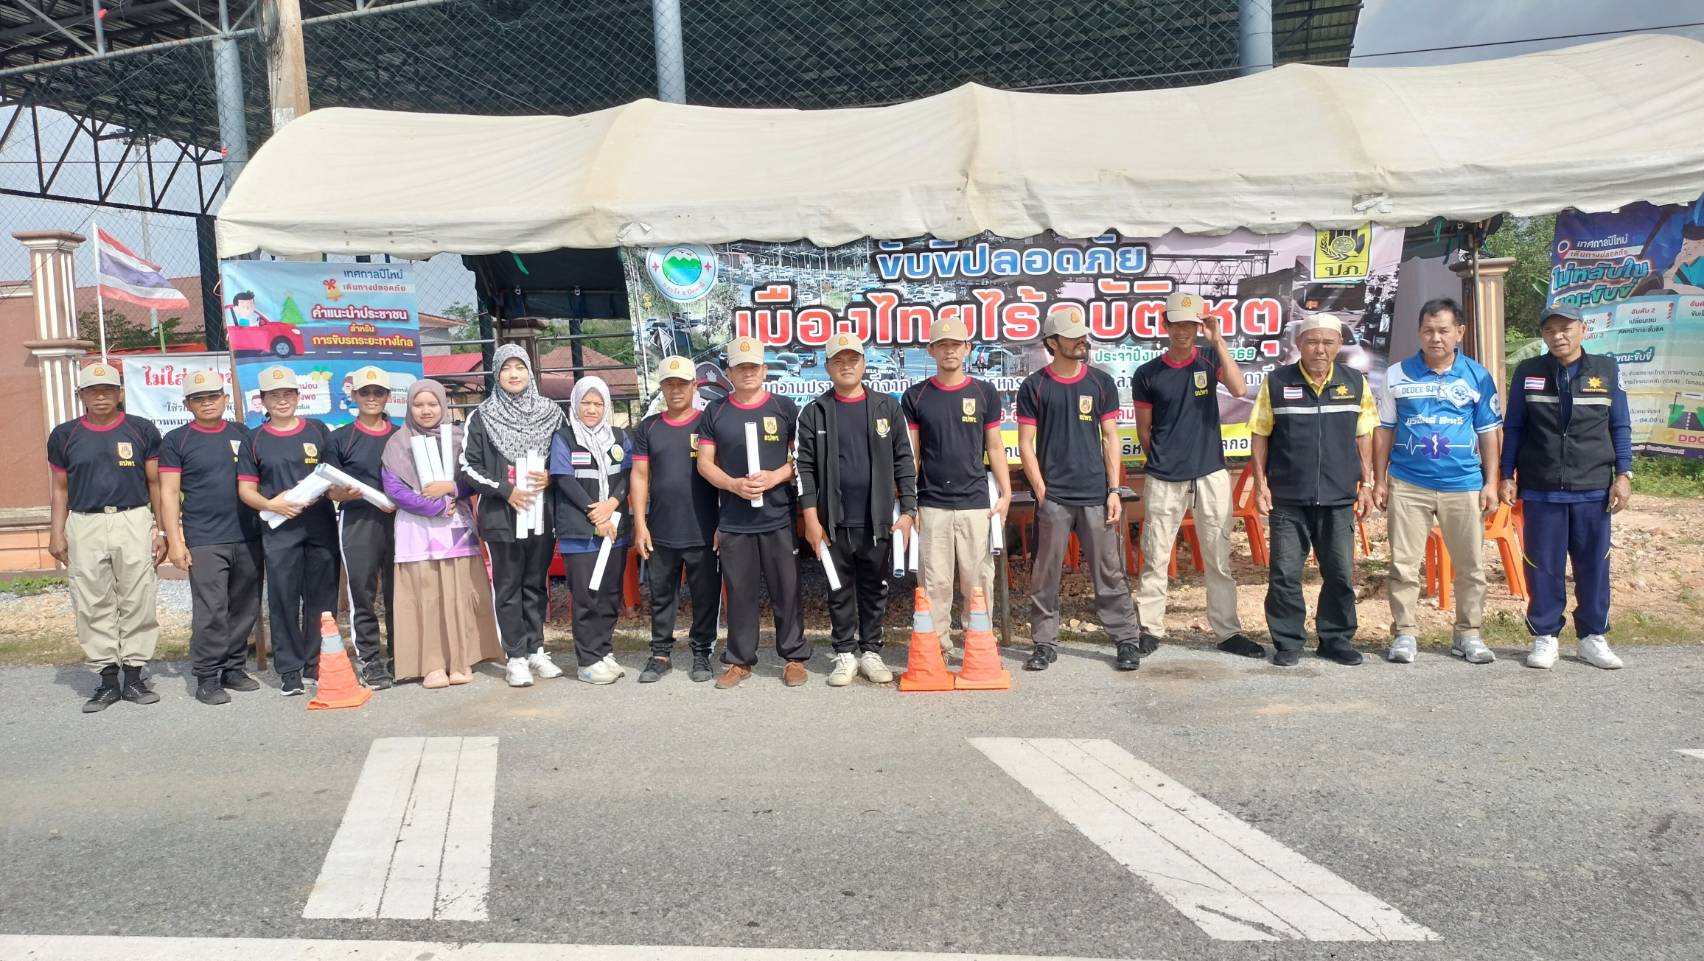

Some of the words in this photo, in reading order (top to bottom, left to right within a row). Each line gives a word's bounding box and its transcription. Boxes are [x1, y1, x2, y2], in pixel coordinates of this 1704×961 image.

[876, 234, 1150, 280] ขับขีปลอดภัย
[343, 269, 404, 280] เทศกาลปีใหม่
[343, 284, 407, 292] เดินทางปลอดภัย
[311, 304, 408, 320] คำแนะนำประชาชน
[311, 335, 415, 347] การขับรถระยะทางไกล
[1227, 348, 1256, 361] 569
